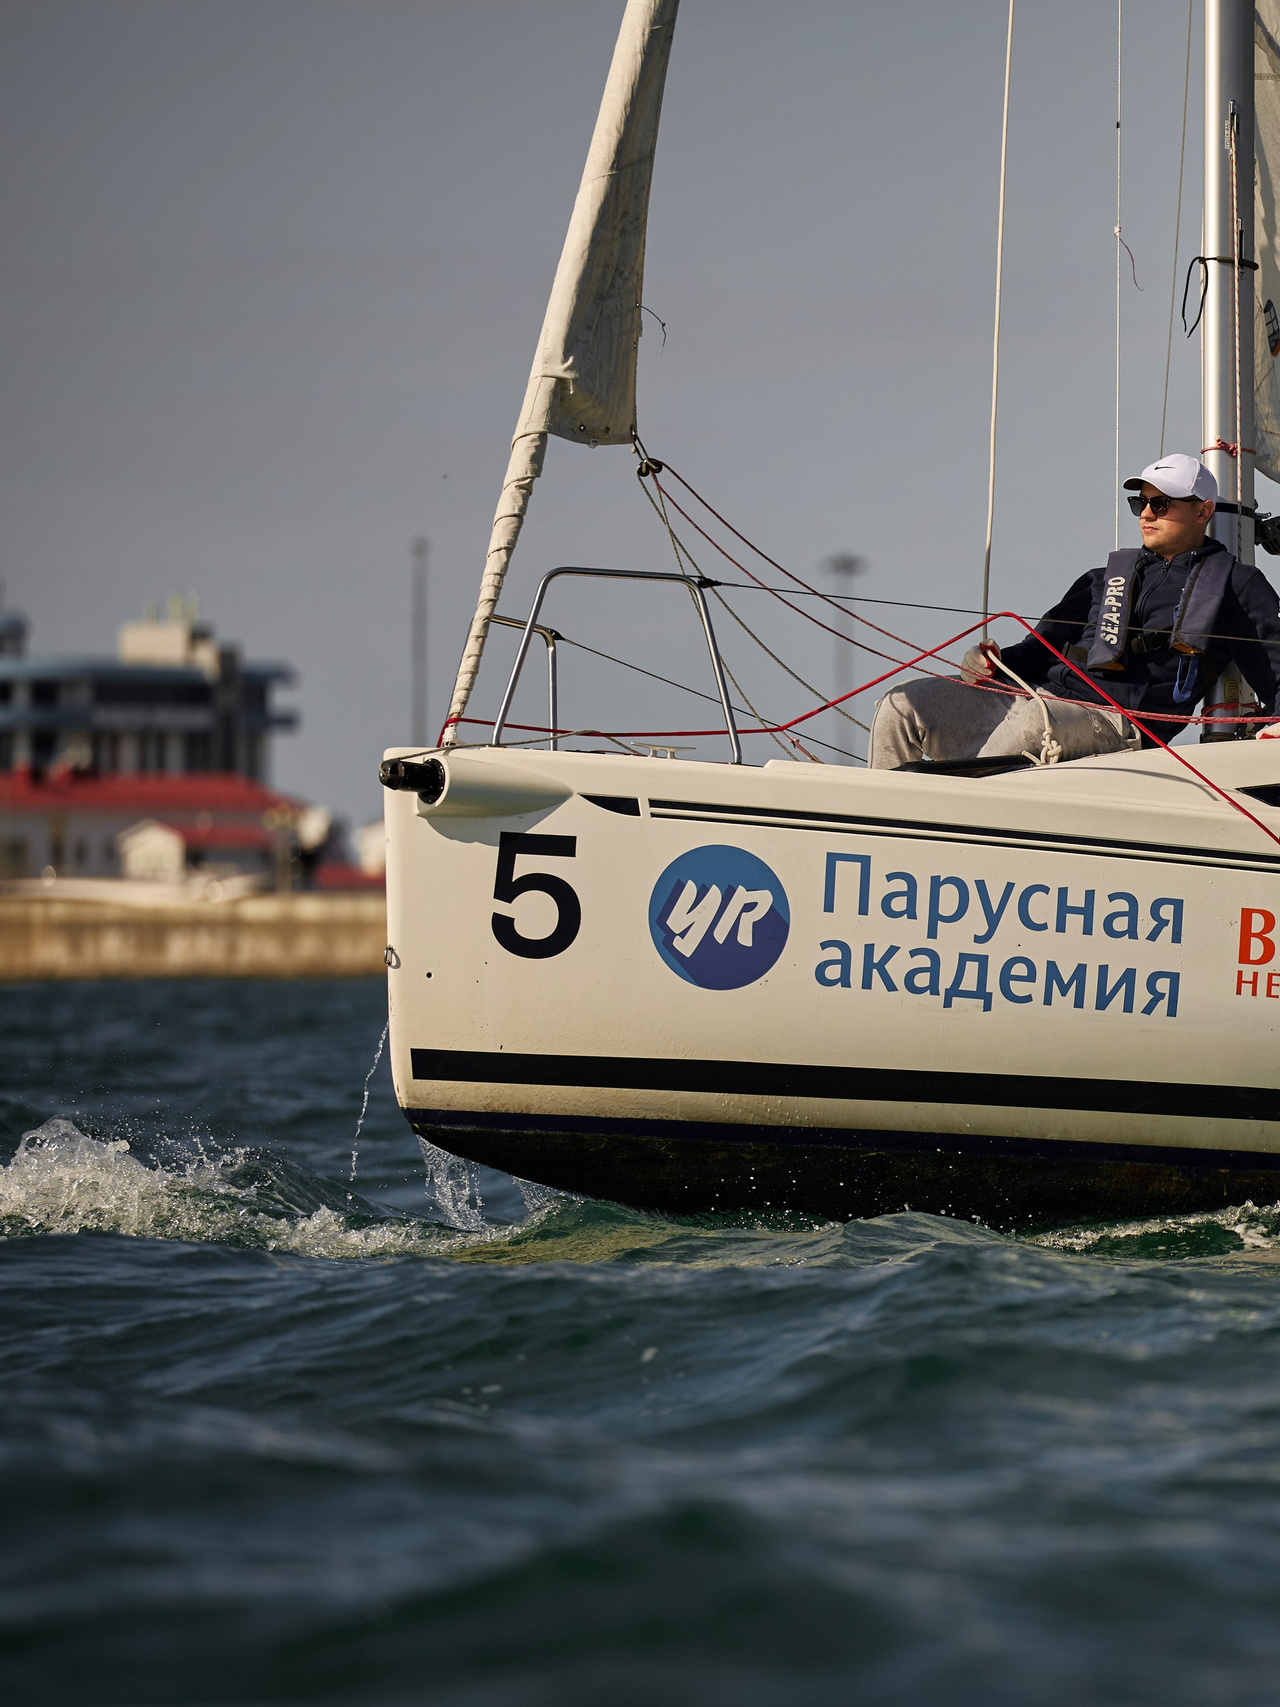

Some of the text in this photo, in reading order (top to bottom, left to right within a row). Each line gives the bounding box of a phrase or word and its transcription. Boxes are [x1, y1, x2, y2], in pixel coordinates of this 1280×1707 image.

[1100, 576, 1126, 645] SEA-PRO
[491, 831, 582, 960] 5
[823, 852, 1184, 945] Парусная
[815, 939, 1180, 1017] академия
